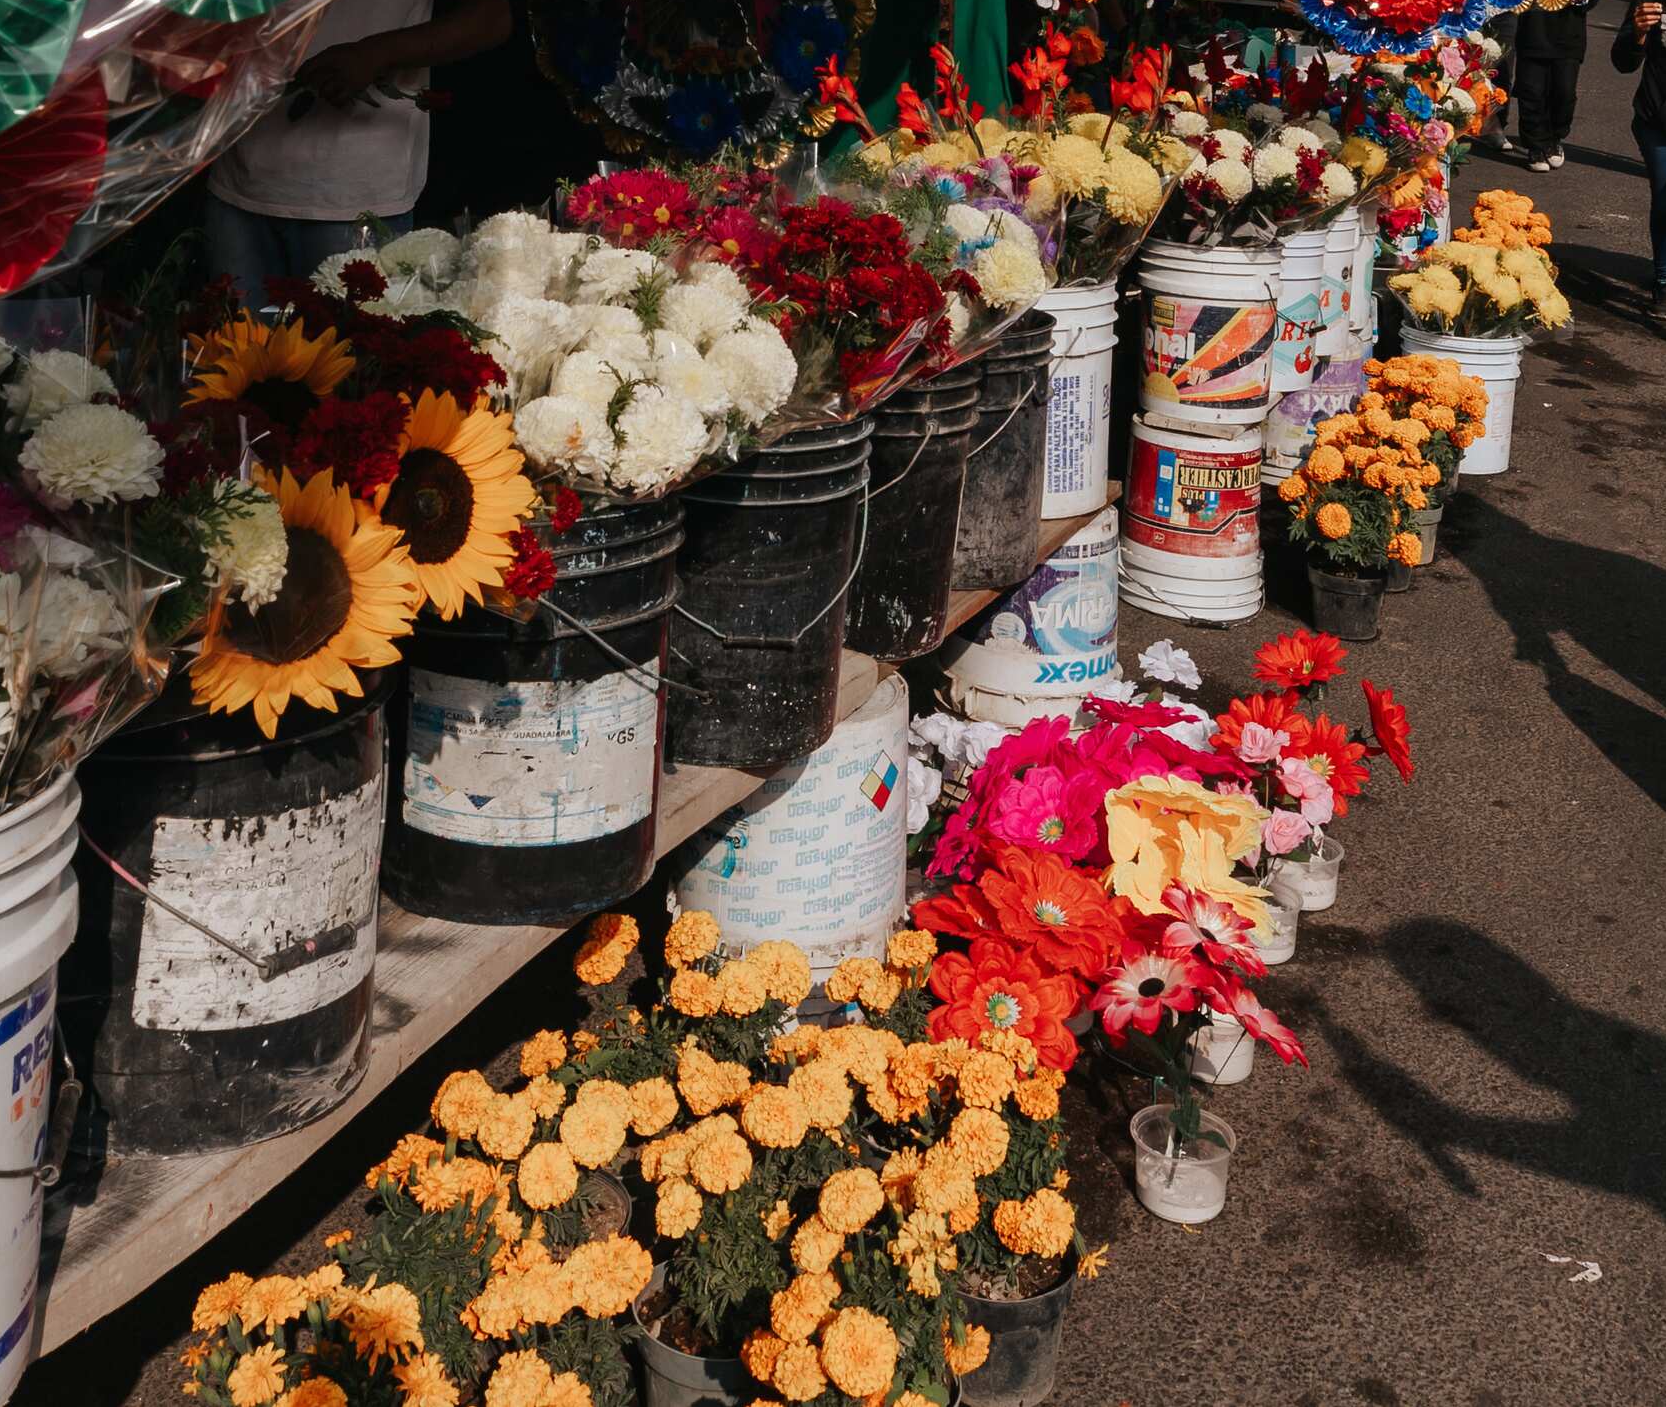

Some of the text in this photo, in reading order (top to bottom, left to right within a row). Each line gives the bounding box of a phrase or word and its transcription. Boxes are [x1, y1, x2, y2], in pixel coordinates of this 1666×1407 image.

[1053, 377, 1061, 411] HELADOS
[1053, 420, 1061, 451] PALETAS
[1053, 454, 1061, 472] PARA
[1053, 474, 1061, 493] BASE
[1180, 466, 1243, 489] CASTHER
